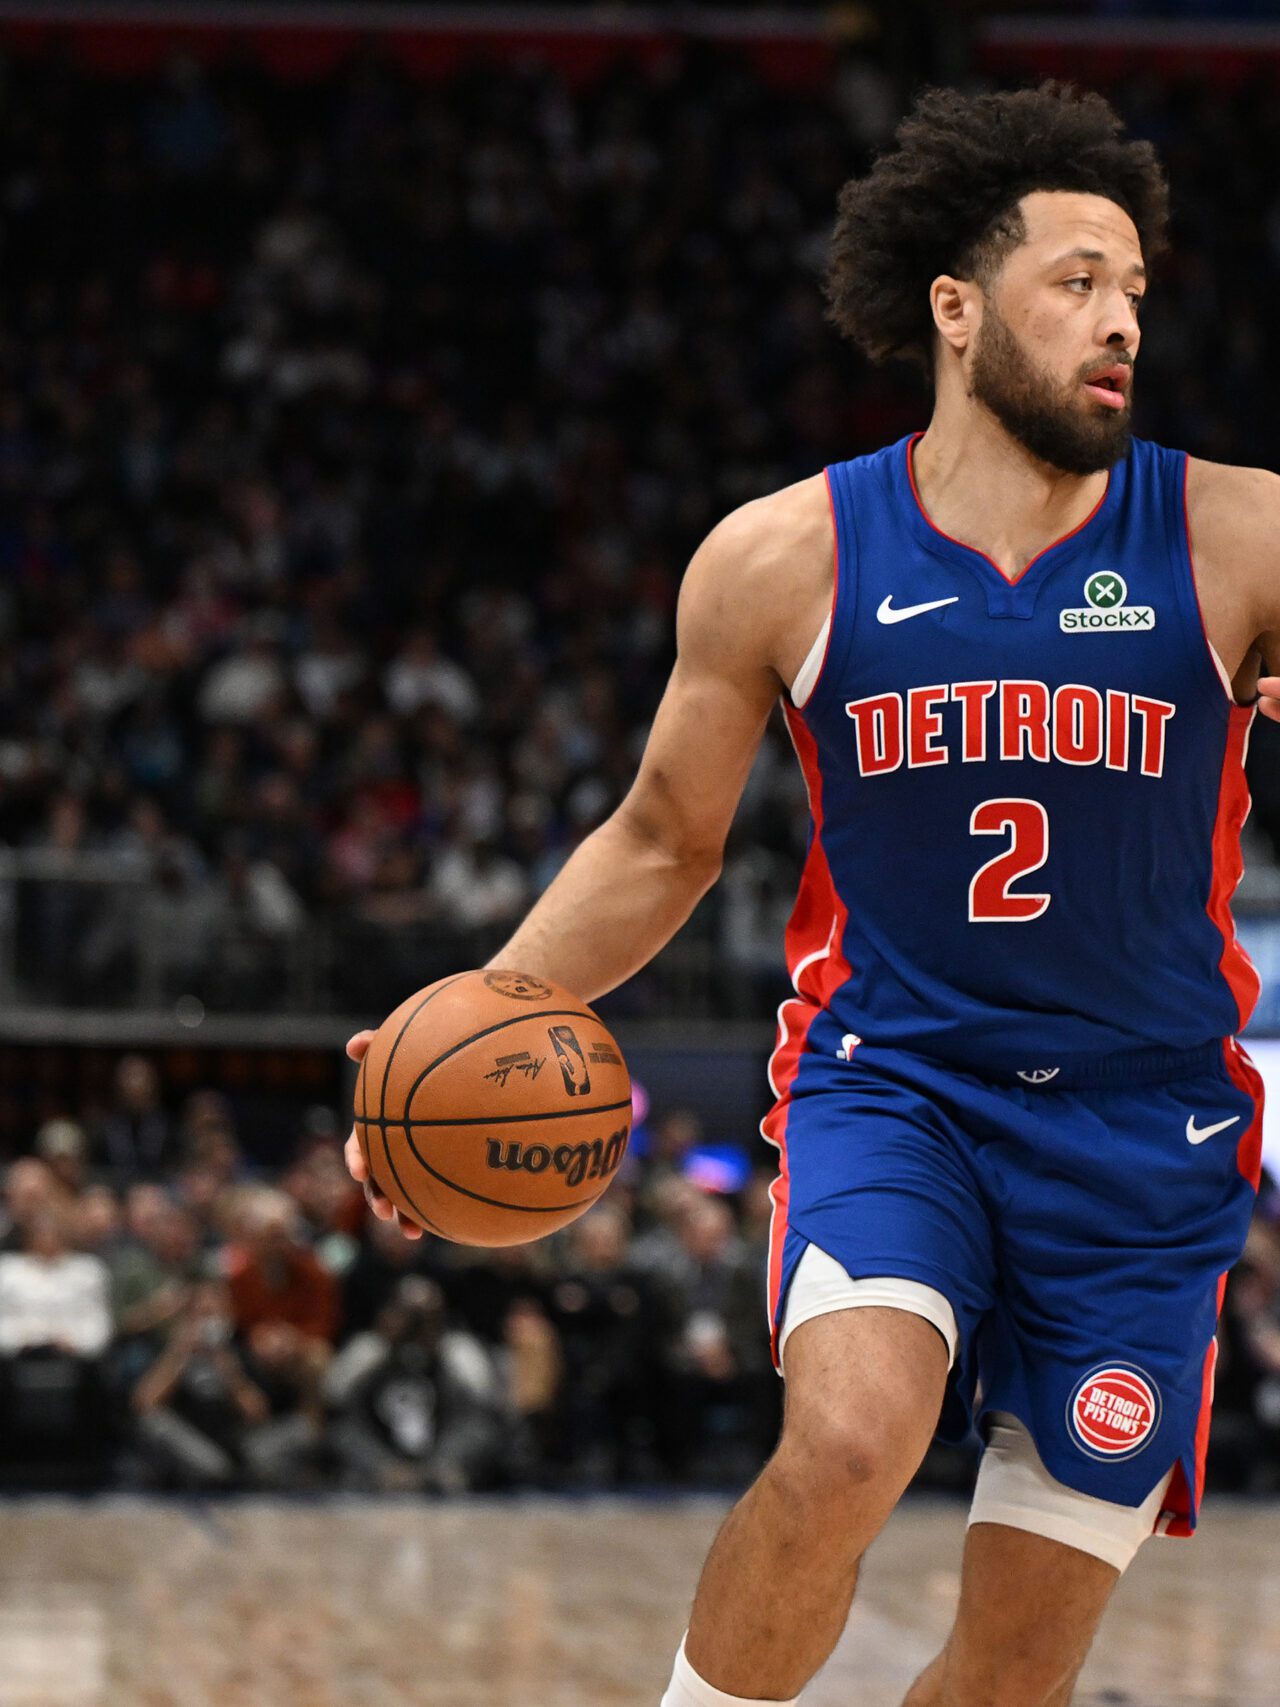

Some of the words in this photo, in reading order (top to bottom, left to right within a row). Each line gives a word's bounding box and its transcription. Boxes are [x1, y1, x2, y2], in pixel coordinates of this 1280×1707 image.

[1063, 610, 1150, 629] StockX
[845, 680, 1176, 778] DETROIT
[968, 797, 1051, 923] 2
[486, 1124, 628, 1187] Wilson
[1083, 1402, 1140, 1435] PISTONS
[1090, 1386, 1145, 1420] DETROIT
